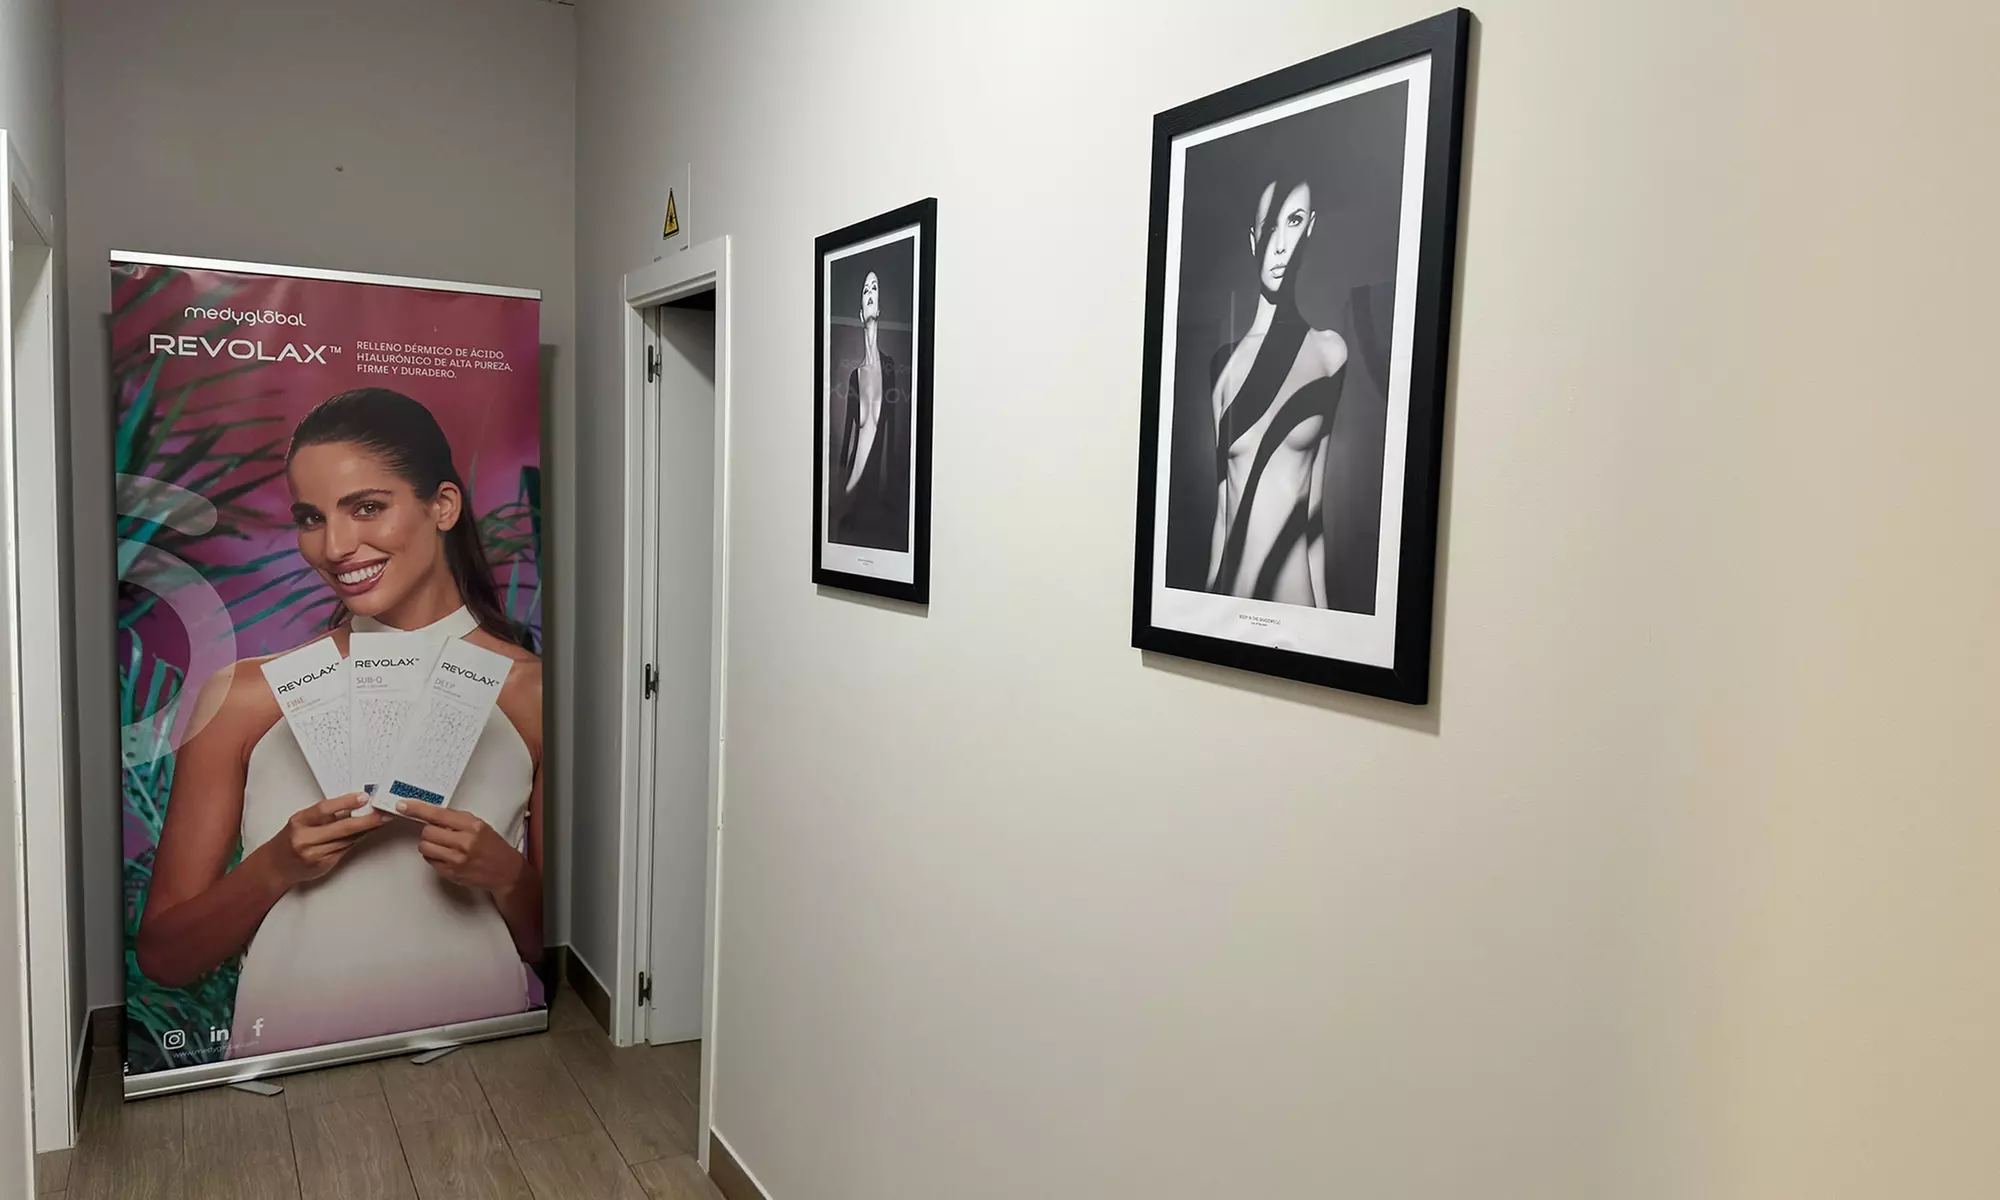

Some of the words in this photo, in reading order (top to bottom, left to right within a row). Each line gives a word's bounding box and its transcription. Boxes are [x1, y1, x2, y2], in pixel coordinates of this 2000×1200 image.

[356, 341, 402, 352] RELLENO
[405, 343, 453, 356] DÉRMICO
[455, 348, 468, 357] DE
[470, 347, 504, 360] ÁCIDO
[356, 352, 432, 366] HIALURÓNICO
[434, 357, 447, 367] DE
[449, 359, 472, 369] ALTA
[474, 361, 513, 372] PUREZA,
[356, 364, 389, 375] FIRME
[391, 366, 398, 375] Y
[401, 366, 457, 379] DURADERO.
